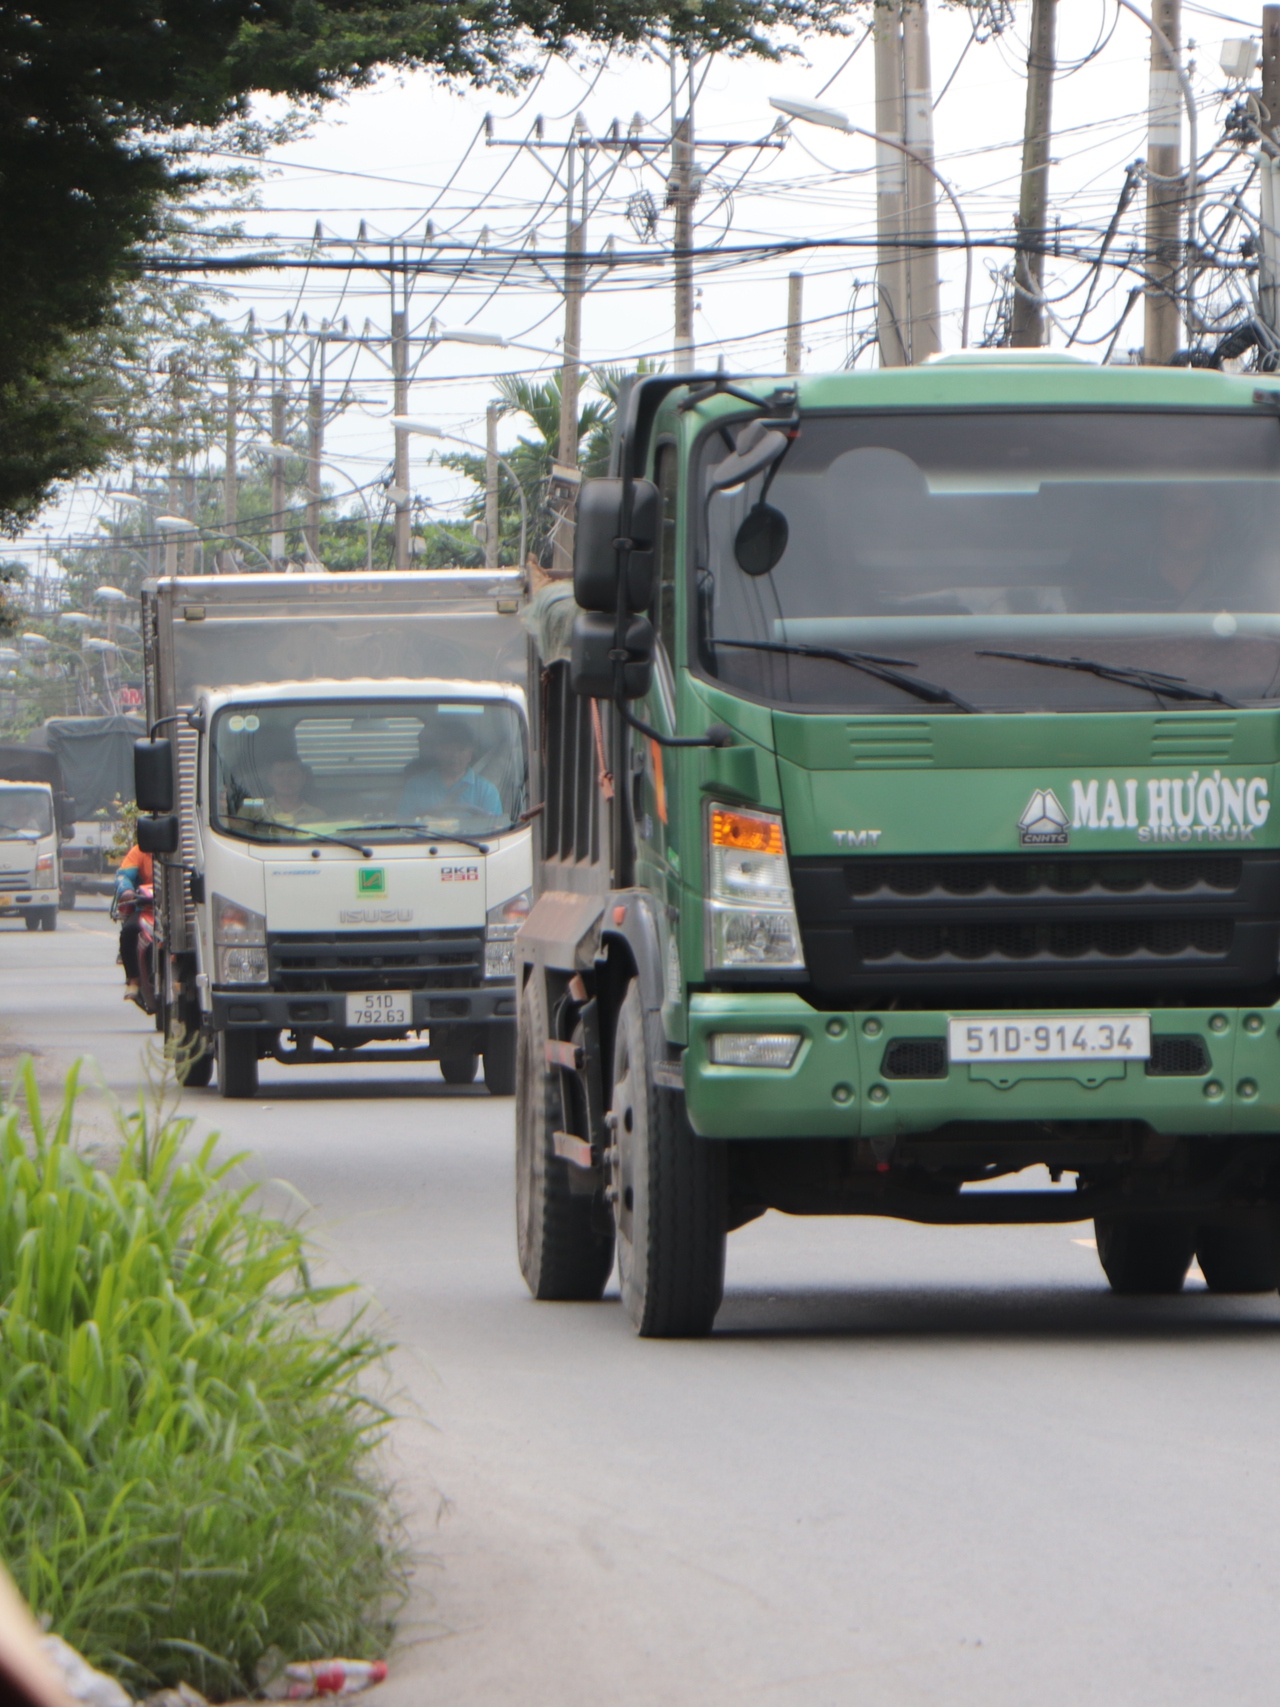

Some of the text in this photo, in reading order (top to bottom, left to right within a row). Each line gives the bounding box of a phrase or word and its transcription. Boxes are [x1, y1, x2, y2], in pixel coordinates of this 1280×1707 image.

[308, 582, 383, 594] ISUZU
[1072, 770, 1270, 829] MAI HƯƠNG
[833, 829, 882, 846] TMT
[1023, 833, 1066, 843] CNHTC
[1137, 824, 1256, 842] SINOTRUK
[339, 908, 414, 924] ISUZU
[365, 994, 393, 1009] 51D
[354, 1009, 405, 1024] 792.63
[966, 1023, 1134, 1054] 51D-914.34
